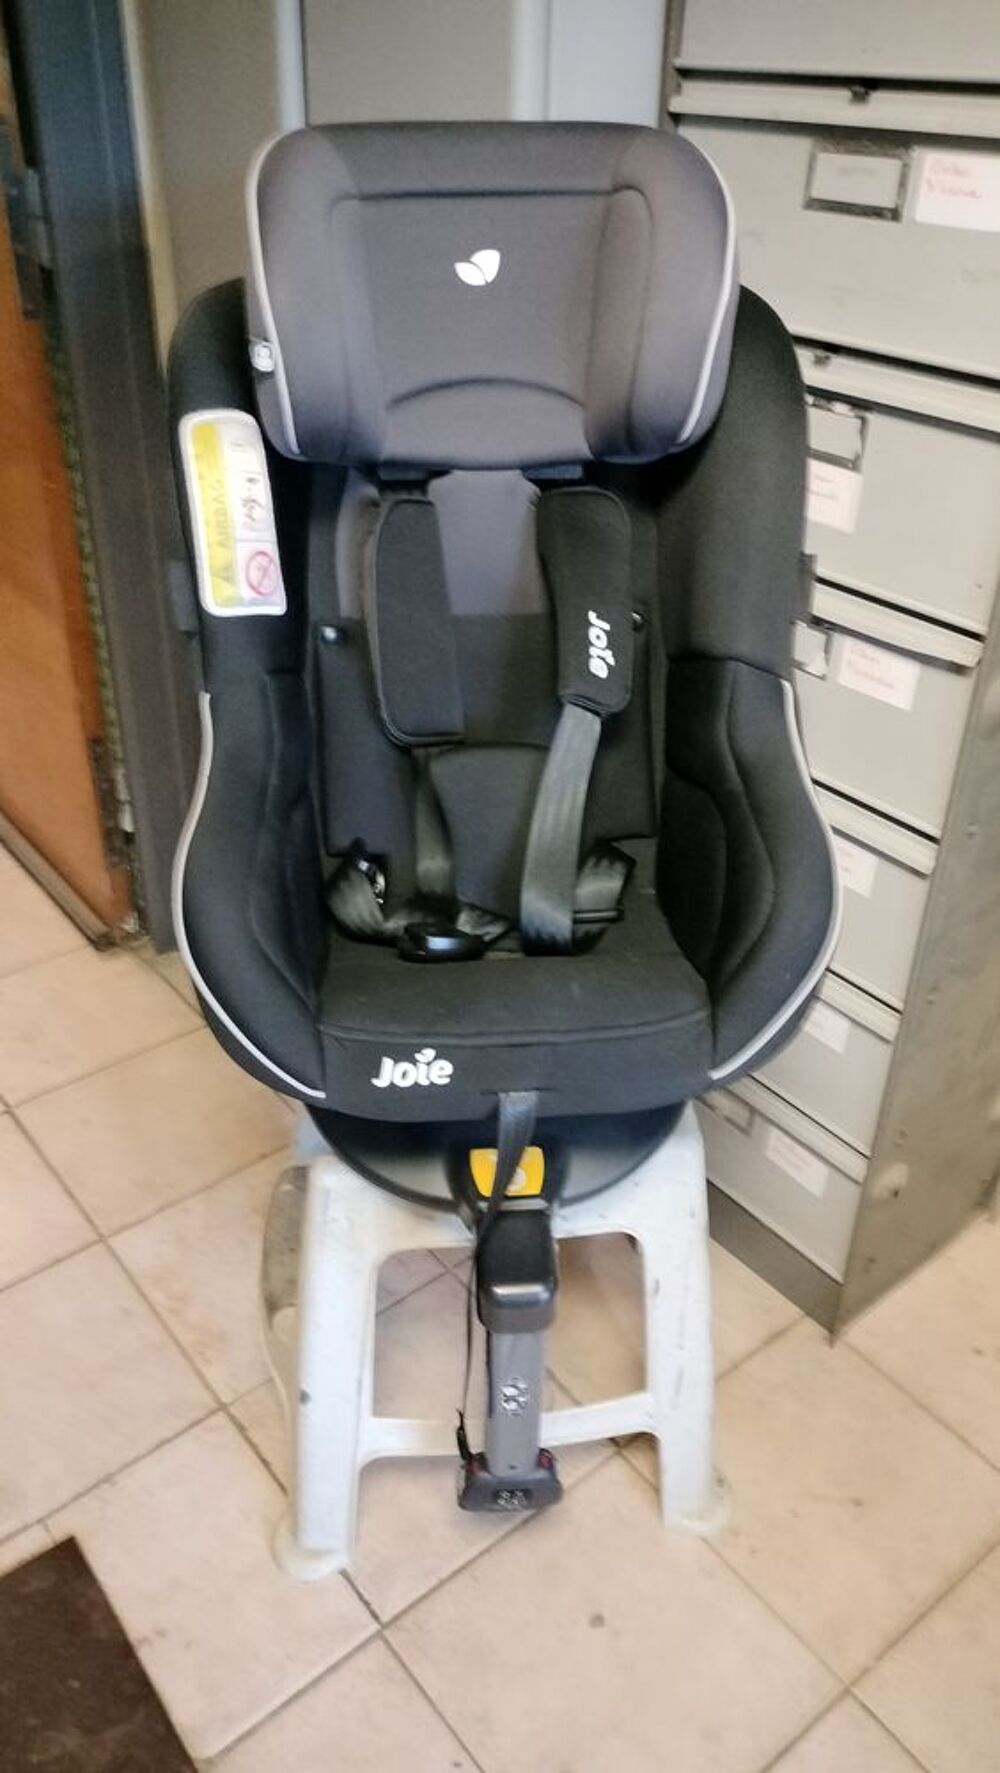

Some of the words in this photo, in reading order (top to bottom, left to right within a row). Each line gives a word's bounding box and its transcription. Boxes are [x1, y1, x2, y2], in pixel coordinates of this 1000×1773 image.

[211, 477, 230, 549] AIRBAG
[588, 610, 616, 679] Joie
[370, 1048, 453, 1088] Joie
